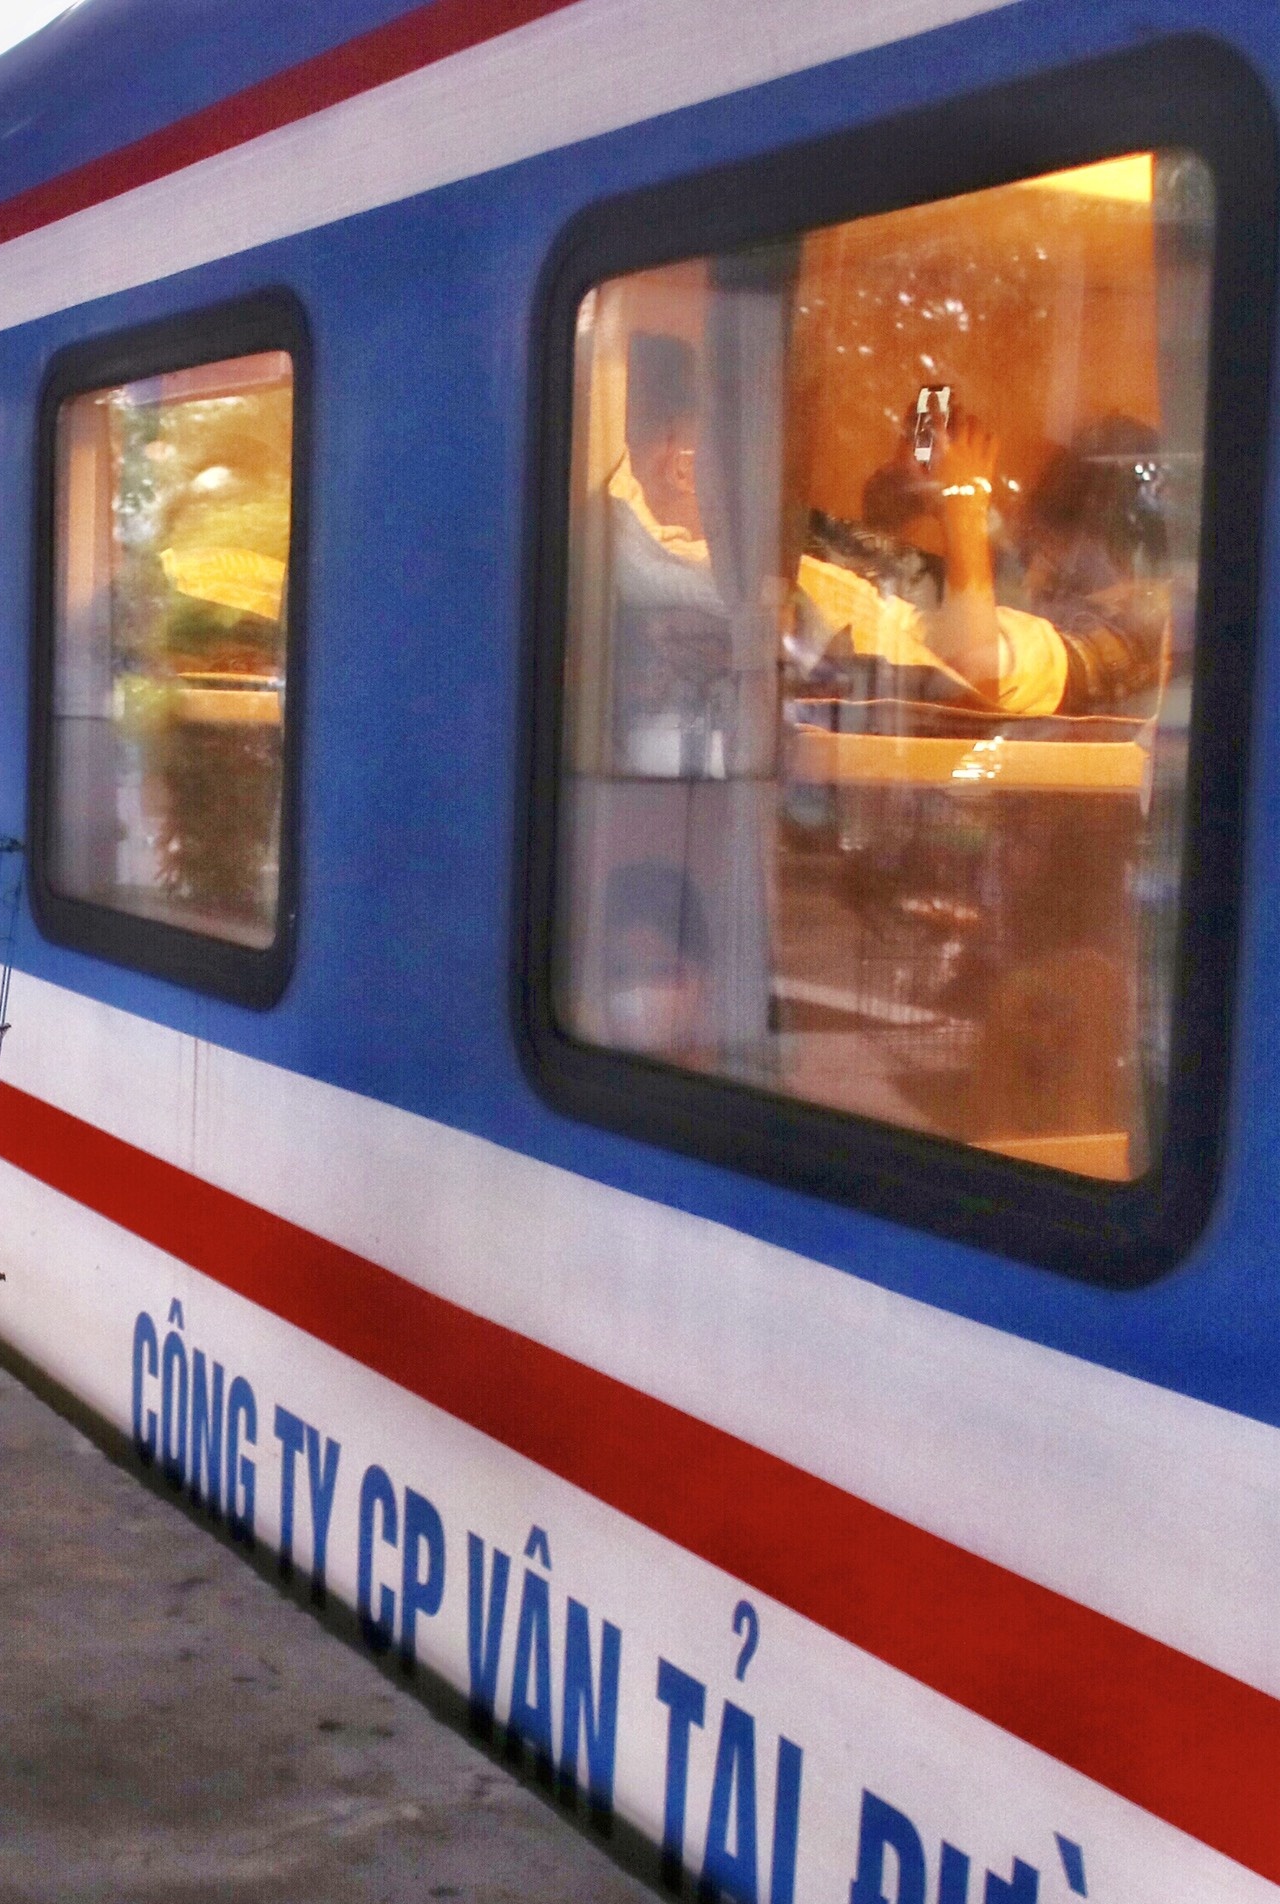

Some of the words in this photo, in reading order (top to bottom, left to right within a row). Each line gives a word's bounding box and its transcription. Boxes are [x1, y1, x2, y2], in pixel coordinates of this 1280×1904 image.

[131, 1297, 257, 1546] CÔNG
[273, 1403, 341, 1612] TY
[356, 1463, 446, 1678] CP
[656, 1599, 804, 1904] TẢI
